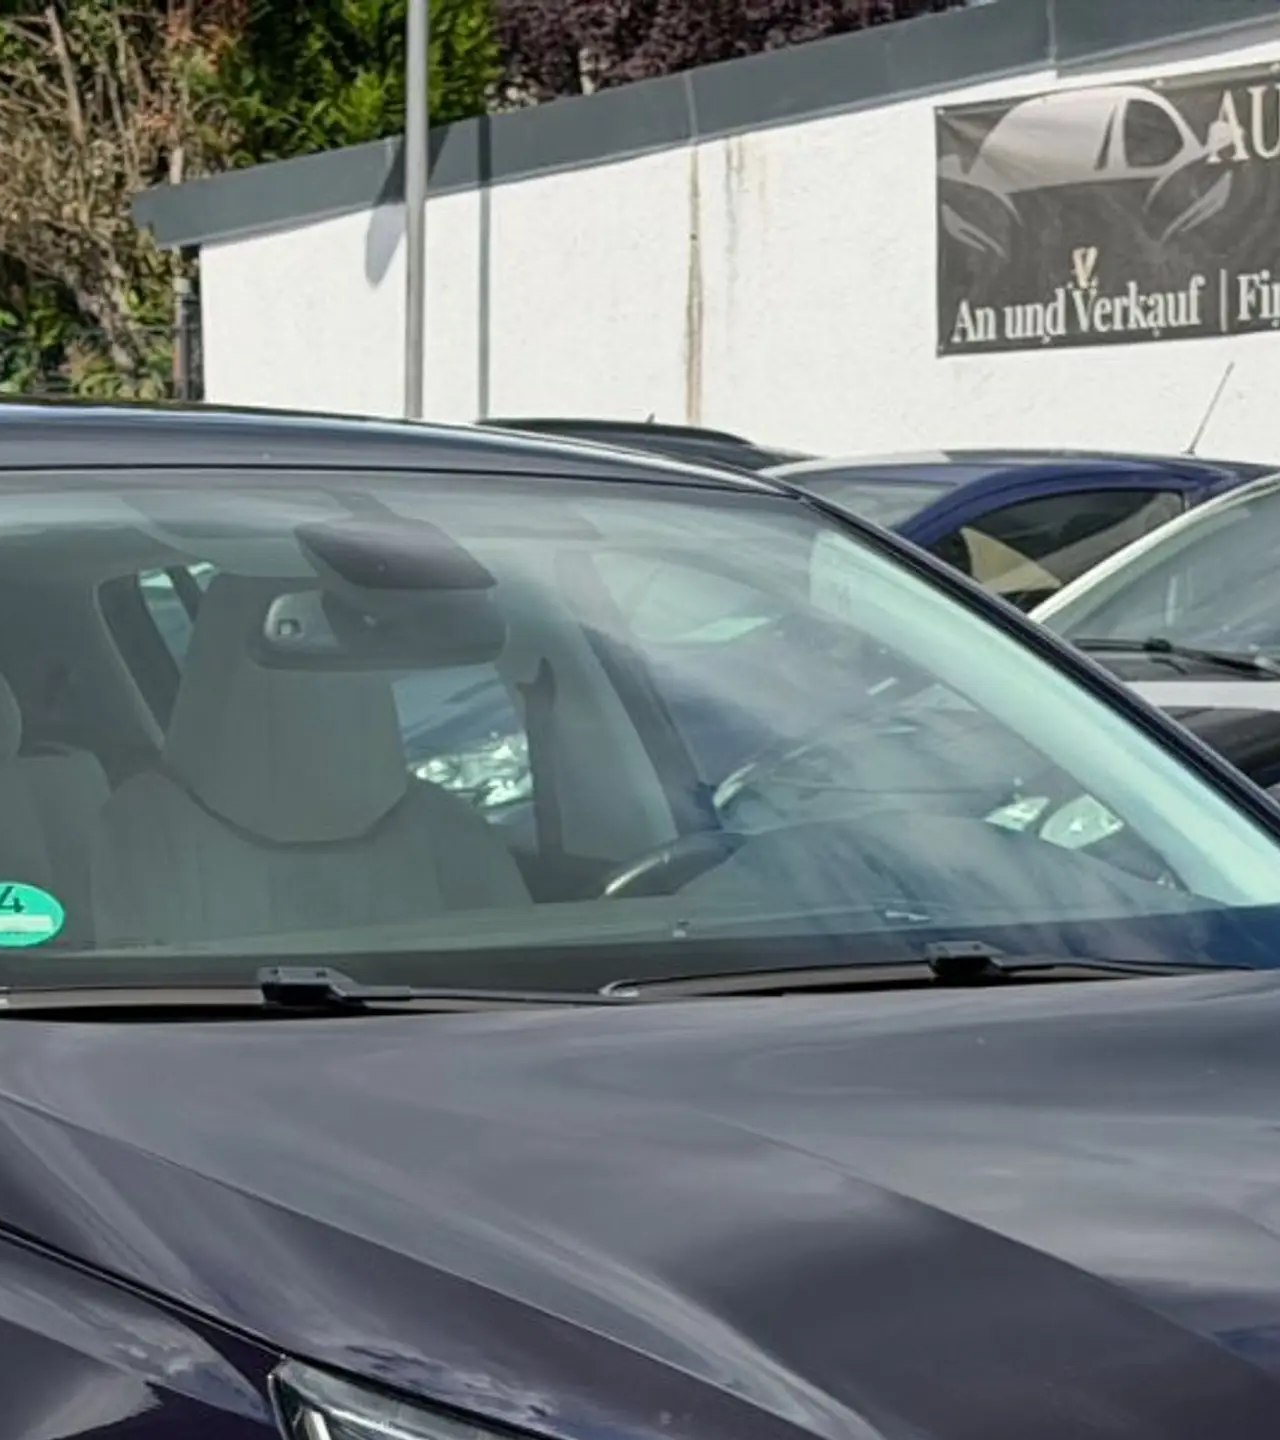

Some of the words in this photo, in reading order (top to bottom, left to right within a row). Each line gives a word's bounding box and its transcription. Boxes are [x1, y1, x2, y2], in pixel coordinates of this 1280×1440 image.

[950, 299, 997, 343] An
[1004, 287, 1067, 342] und
[1070, 274, 1207, 334] Verkauf
